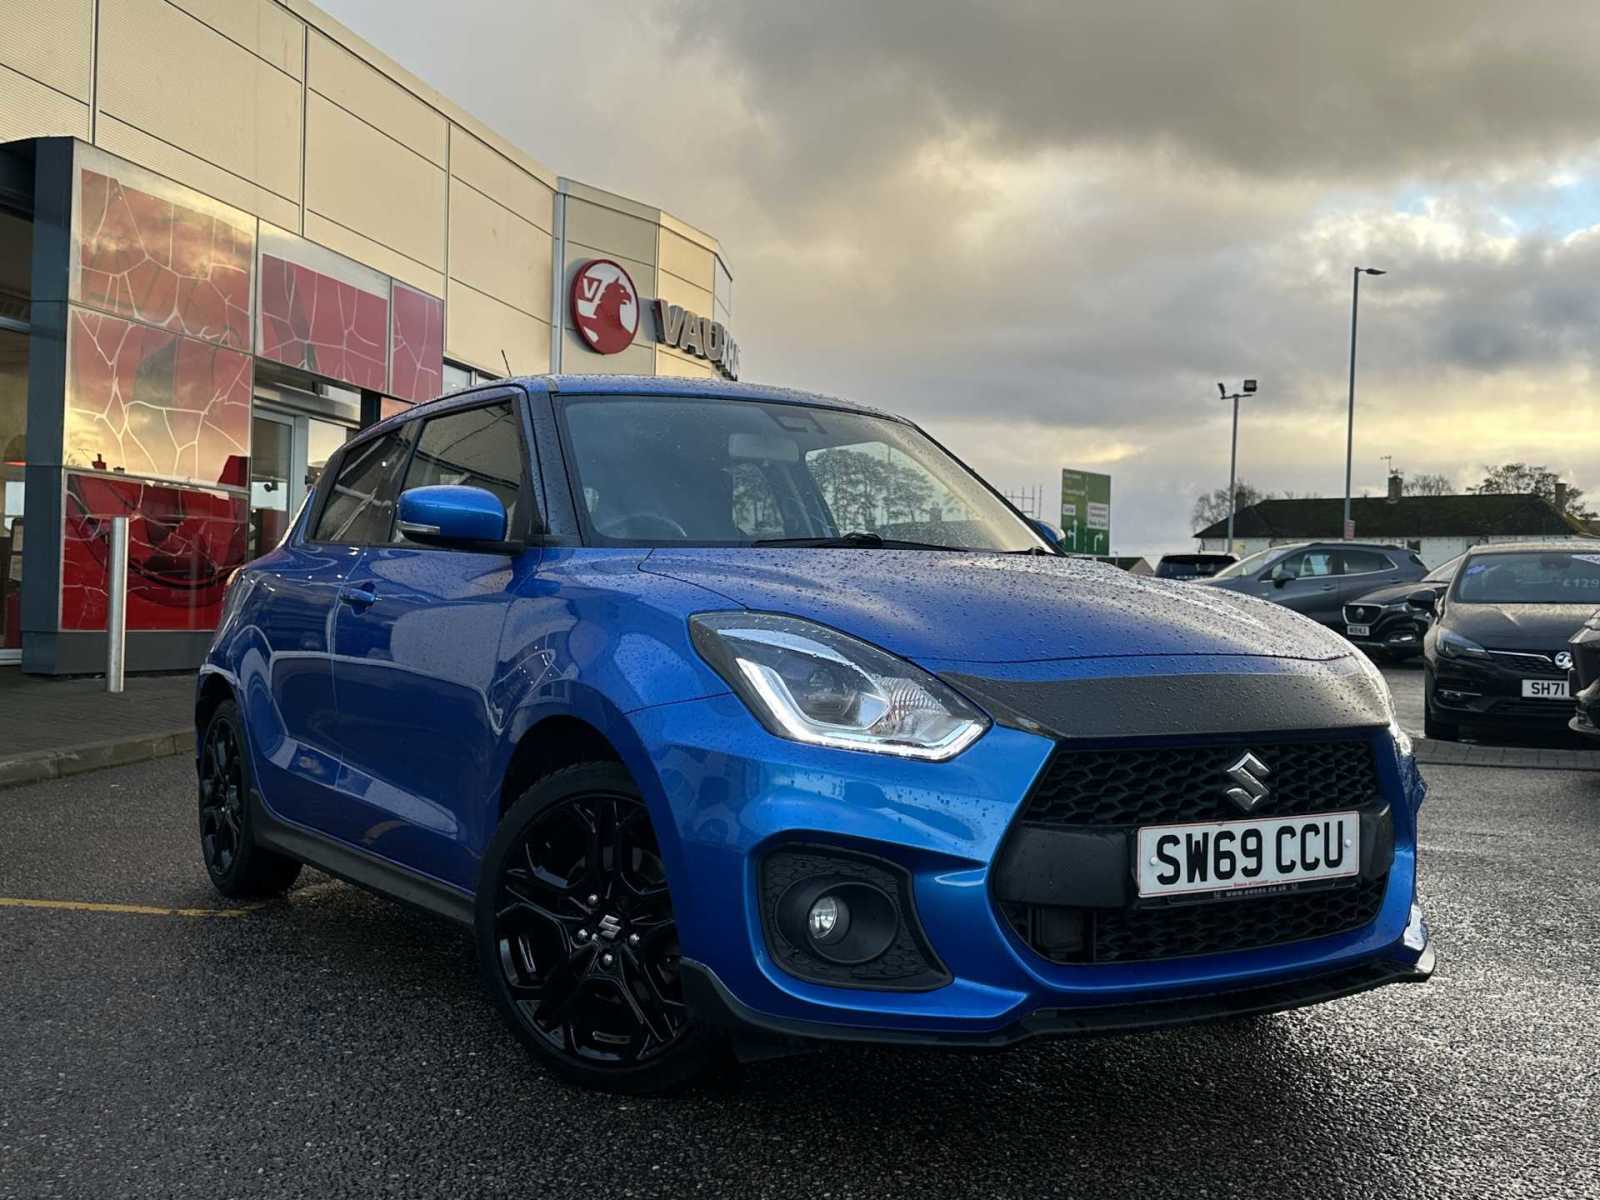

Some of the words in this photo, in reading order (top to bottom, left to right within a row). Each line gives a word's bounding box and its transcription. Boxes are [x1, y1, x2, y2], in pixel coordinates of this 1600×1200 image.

[1531, 682, 1565, 696] SH71
[1156, 828, 1263, 886] SW69
[1276, 820, 1344, 874] CCU
